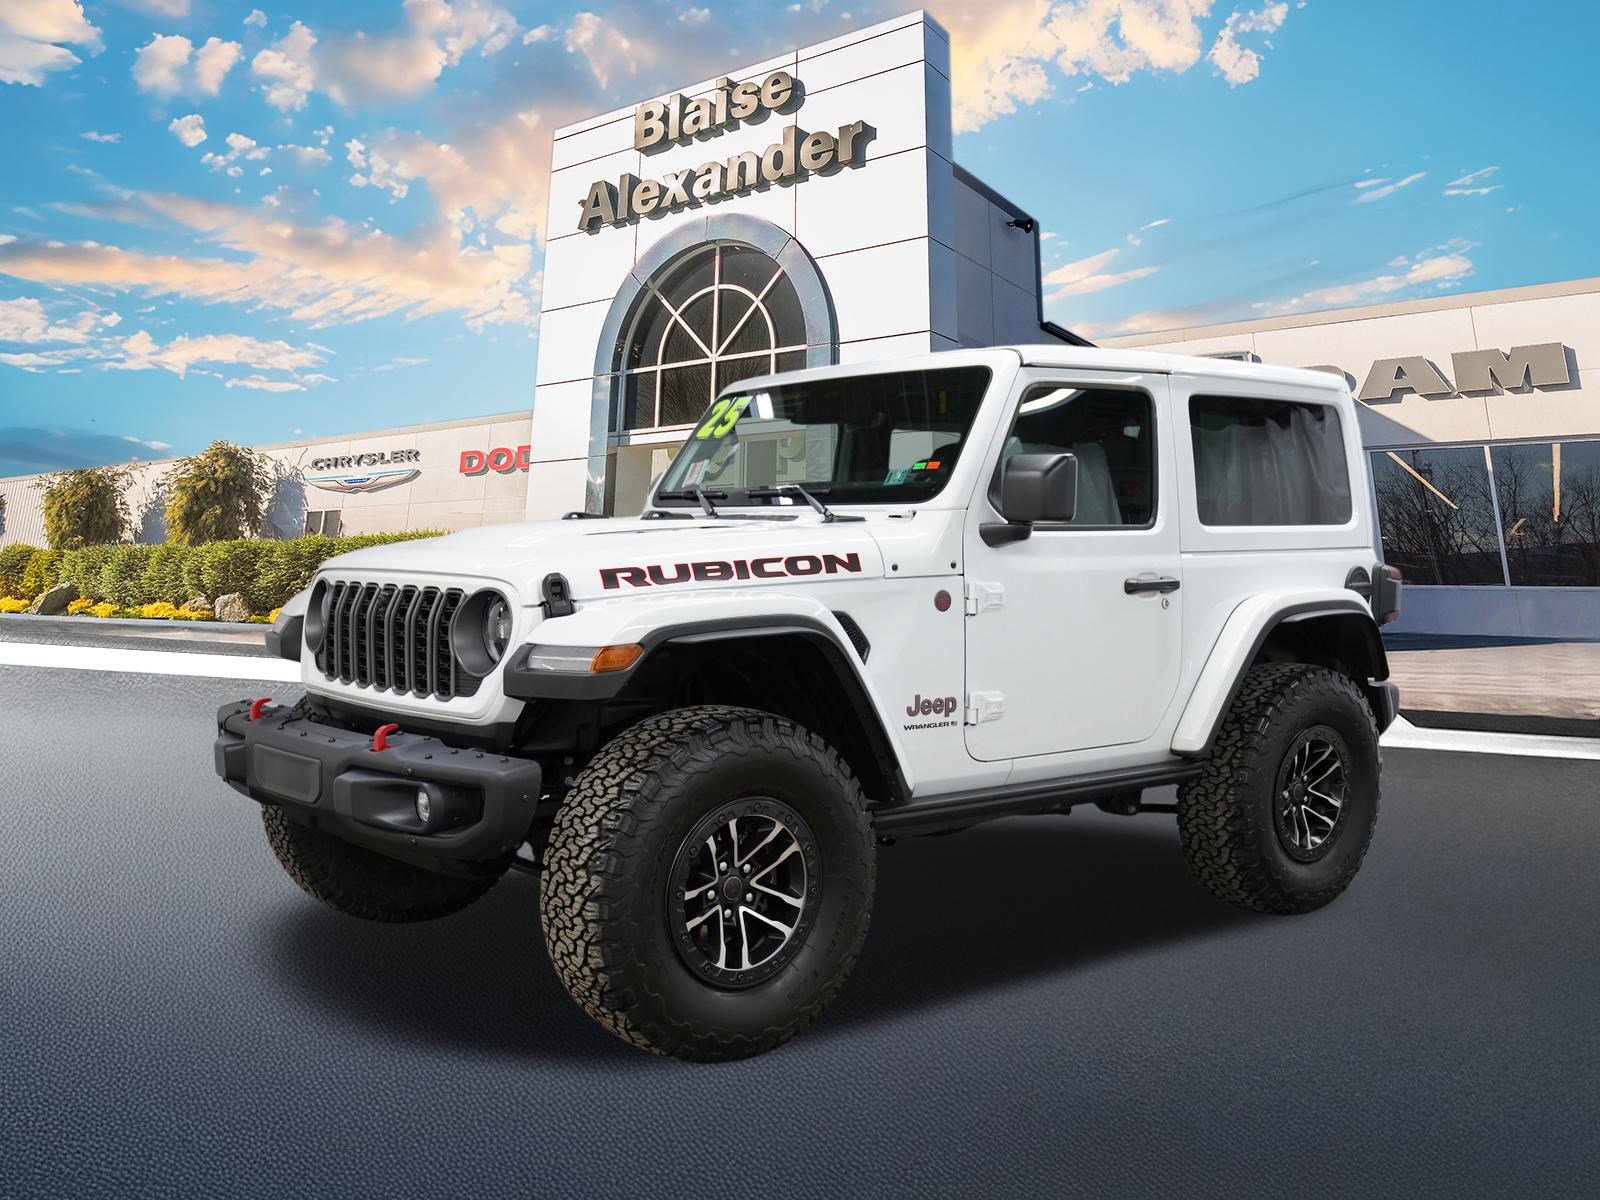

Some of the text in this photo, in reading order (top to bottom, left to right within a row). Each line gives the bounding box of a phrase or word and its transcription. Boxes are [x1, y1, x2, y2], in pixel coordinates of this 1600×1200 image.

[634, 71, 802, 154] Blaise
[577, 119, 874, 233] Alexander
[1303, 342, 1573, 402] AM
[696, 395, 753, 439] 25
[311, 448, 420, 471] CHRYSLER
[599, 552, 862, 589] RUBICON
[903, 720, 950, 731] WRANGLER
[906, 694, 957, 718] Jeep
